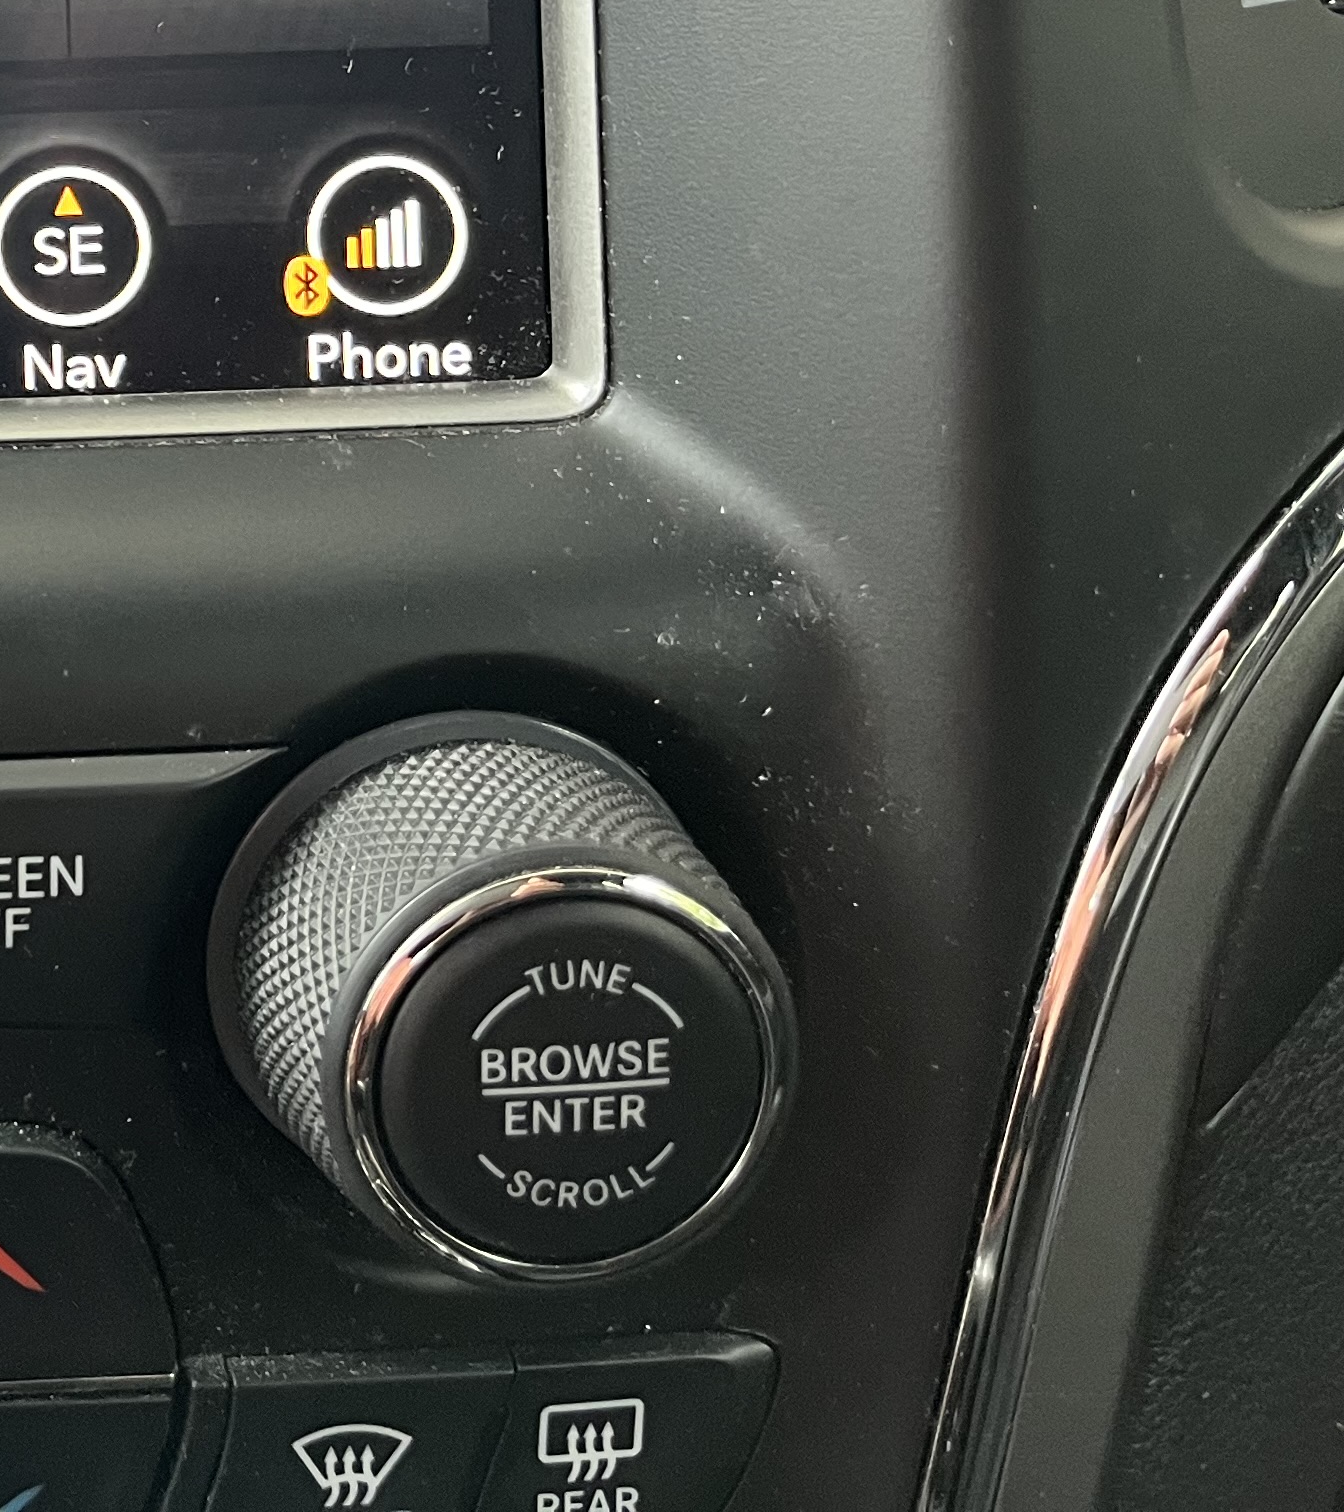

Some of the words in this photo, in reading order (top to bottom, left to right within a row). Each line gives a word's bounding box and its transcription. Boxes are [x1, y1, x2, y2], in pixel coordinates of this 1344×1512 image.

[33, 224, 106, 276] SE
[23, 343, 127, 393] Nav
[307, 329, 473, 385] Phone
[525, 959, 632, 996] TUNE
[480, 1037, 671, 1085] BROWSE
[504, 1094, 646, 1136] ENTER
[505, 1166, 656, 1209] SCROLL
[536, 1486, 639, 1512] REAR
